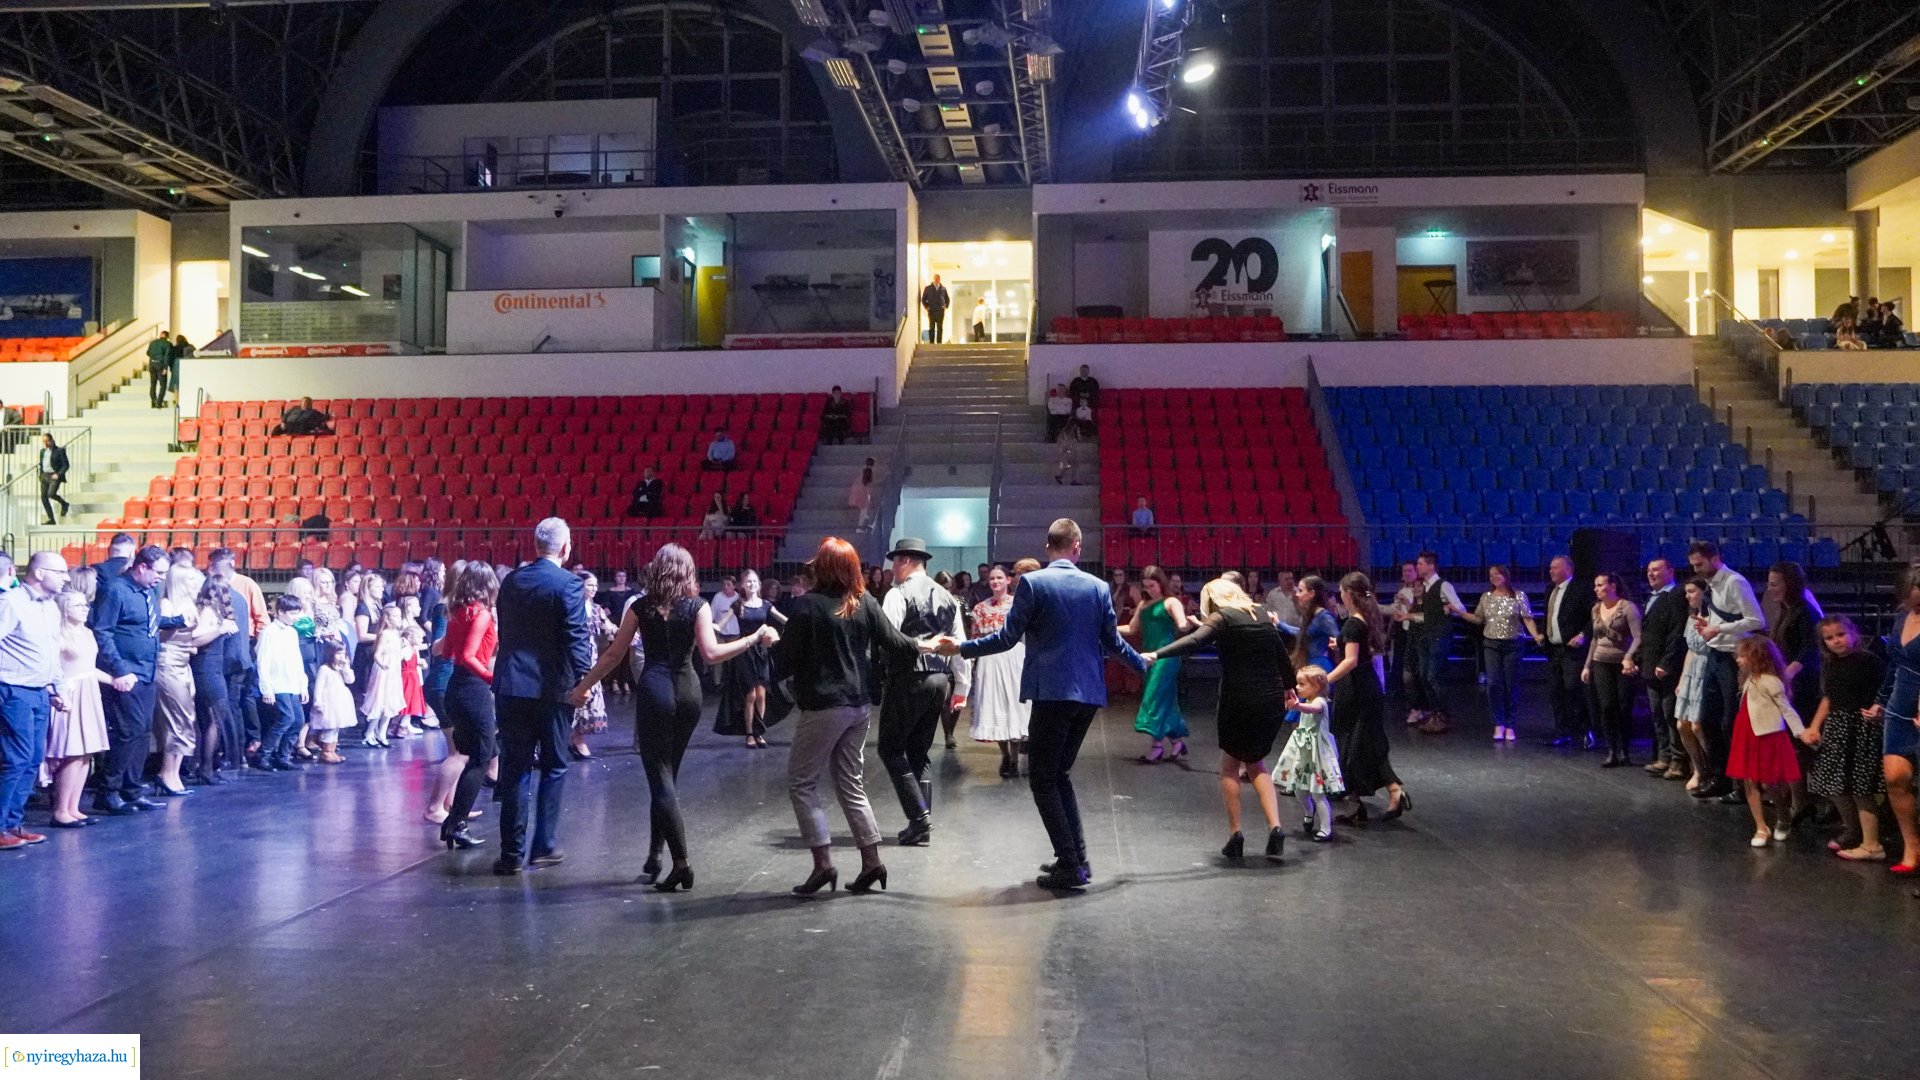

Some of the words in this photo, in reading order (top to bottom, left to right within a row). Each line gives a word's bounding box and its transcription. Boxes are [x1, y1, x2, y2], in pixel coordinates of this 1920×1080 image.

[1328, 182, 1379, 194] Eissmann
[1191, 237, 1280, 293] 20
[494, 292, 592, 314] Continental
[1221, 290, 1274, 302] Eissmann
